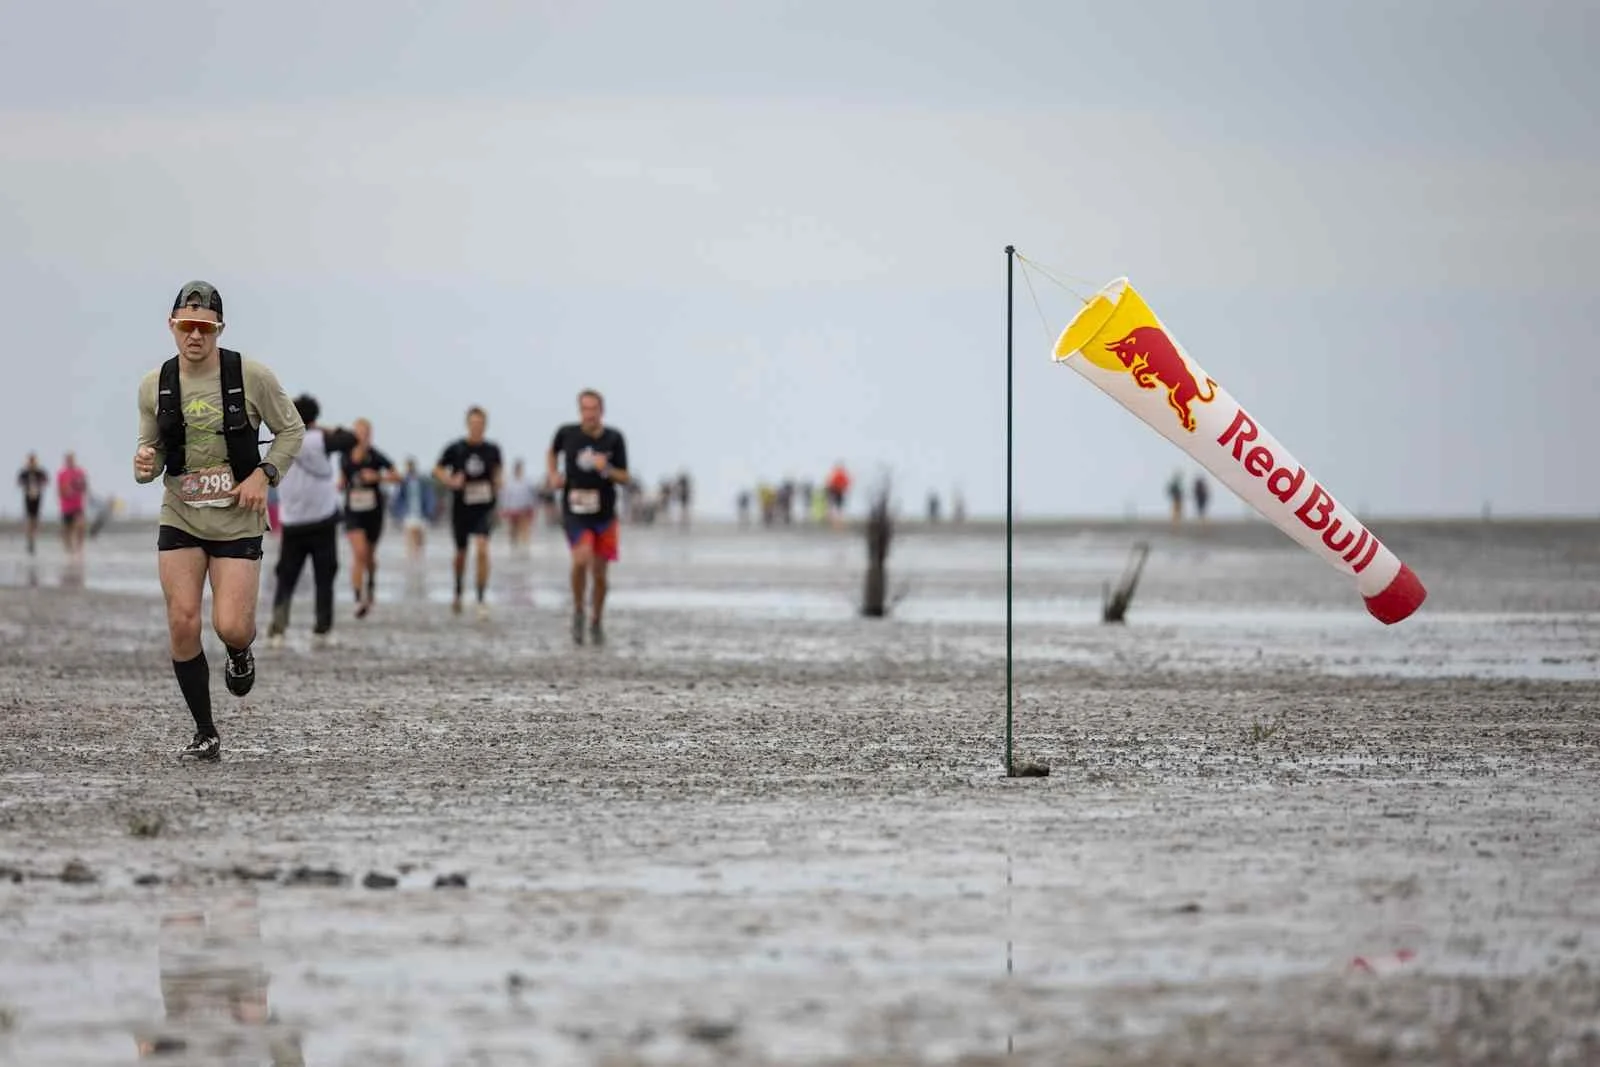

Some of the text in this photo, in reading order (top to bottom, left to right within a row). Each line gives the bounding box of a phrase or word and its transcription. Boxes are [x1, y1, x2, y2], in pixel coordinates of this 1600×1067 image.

[200, 473, 232, 494] 298
[1217, 410, 1379, 574] Red Bull
